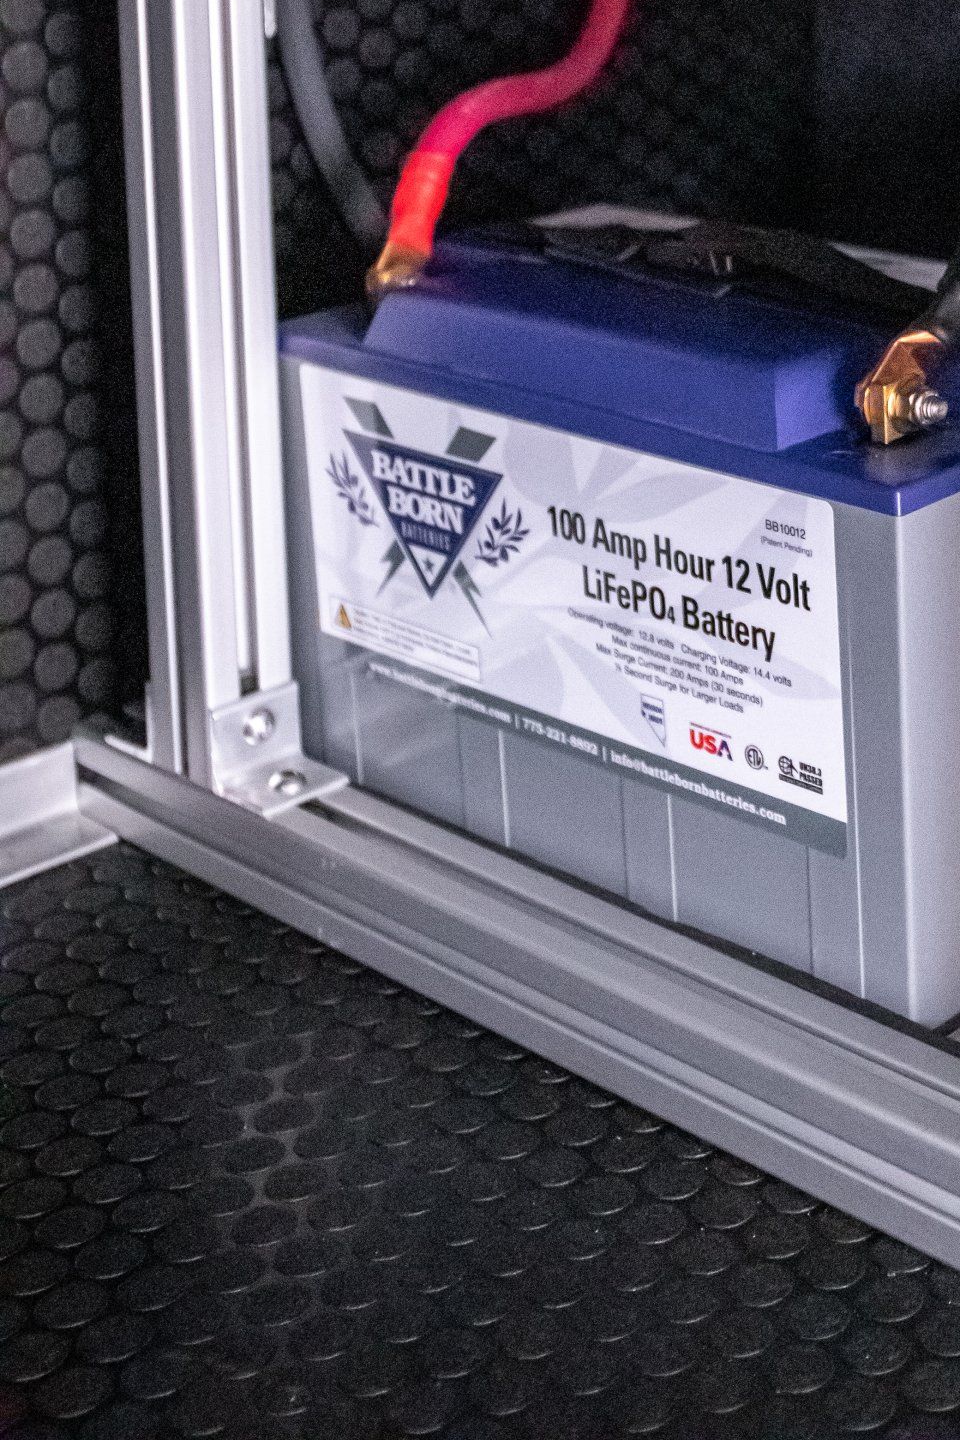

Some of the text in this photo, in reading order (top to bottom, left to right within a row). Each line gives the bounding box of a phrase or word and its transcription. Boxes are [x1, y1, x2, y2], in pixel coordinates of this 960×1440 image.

[370, 449, 477, 507] BATTLE
[385, 485, 465, 536] BORN
[401, 521, 451, 551] BATTERIES
[764, 519, 806, 540] BB10012
[547, 505, 812, 612] 100 Amp Hour 12 Volt
[787, 541, 813, 558] Pending)
[567, 606, 604, 629] Operating
[656, 636, 675, 650] volts
[680, 643, 717, 665] Charging
[718, 656, 751, 675] Voltage:
[753, 666, 770, 680] 14.4
[772, 674, 793, 688] volts
[681, 594, 776, 663] Battery
[595, 642, 612, 657] Max
[613, 648, 636, 664] Surge
[670, 667, 685, 679] 200
[686, 672, 709, 689] Amps
[711, 680, 724, 694] (30
[726, 685, 764, 708] seconds)
[611, 634, 628, 649] Max
[629, 641, 671, 662] continuous
[704, 664, 719, 678] 100
[720, 670, 744, 686] Amps
[624, 665, 653, 684] Second
[654, 675, 678, 693] Surge
[679, 683, 690, 695] for
[691, 688, 717, 705] Larger
[719, 697, 744, 714] Loads
[689, 728, 733, 762] USA
